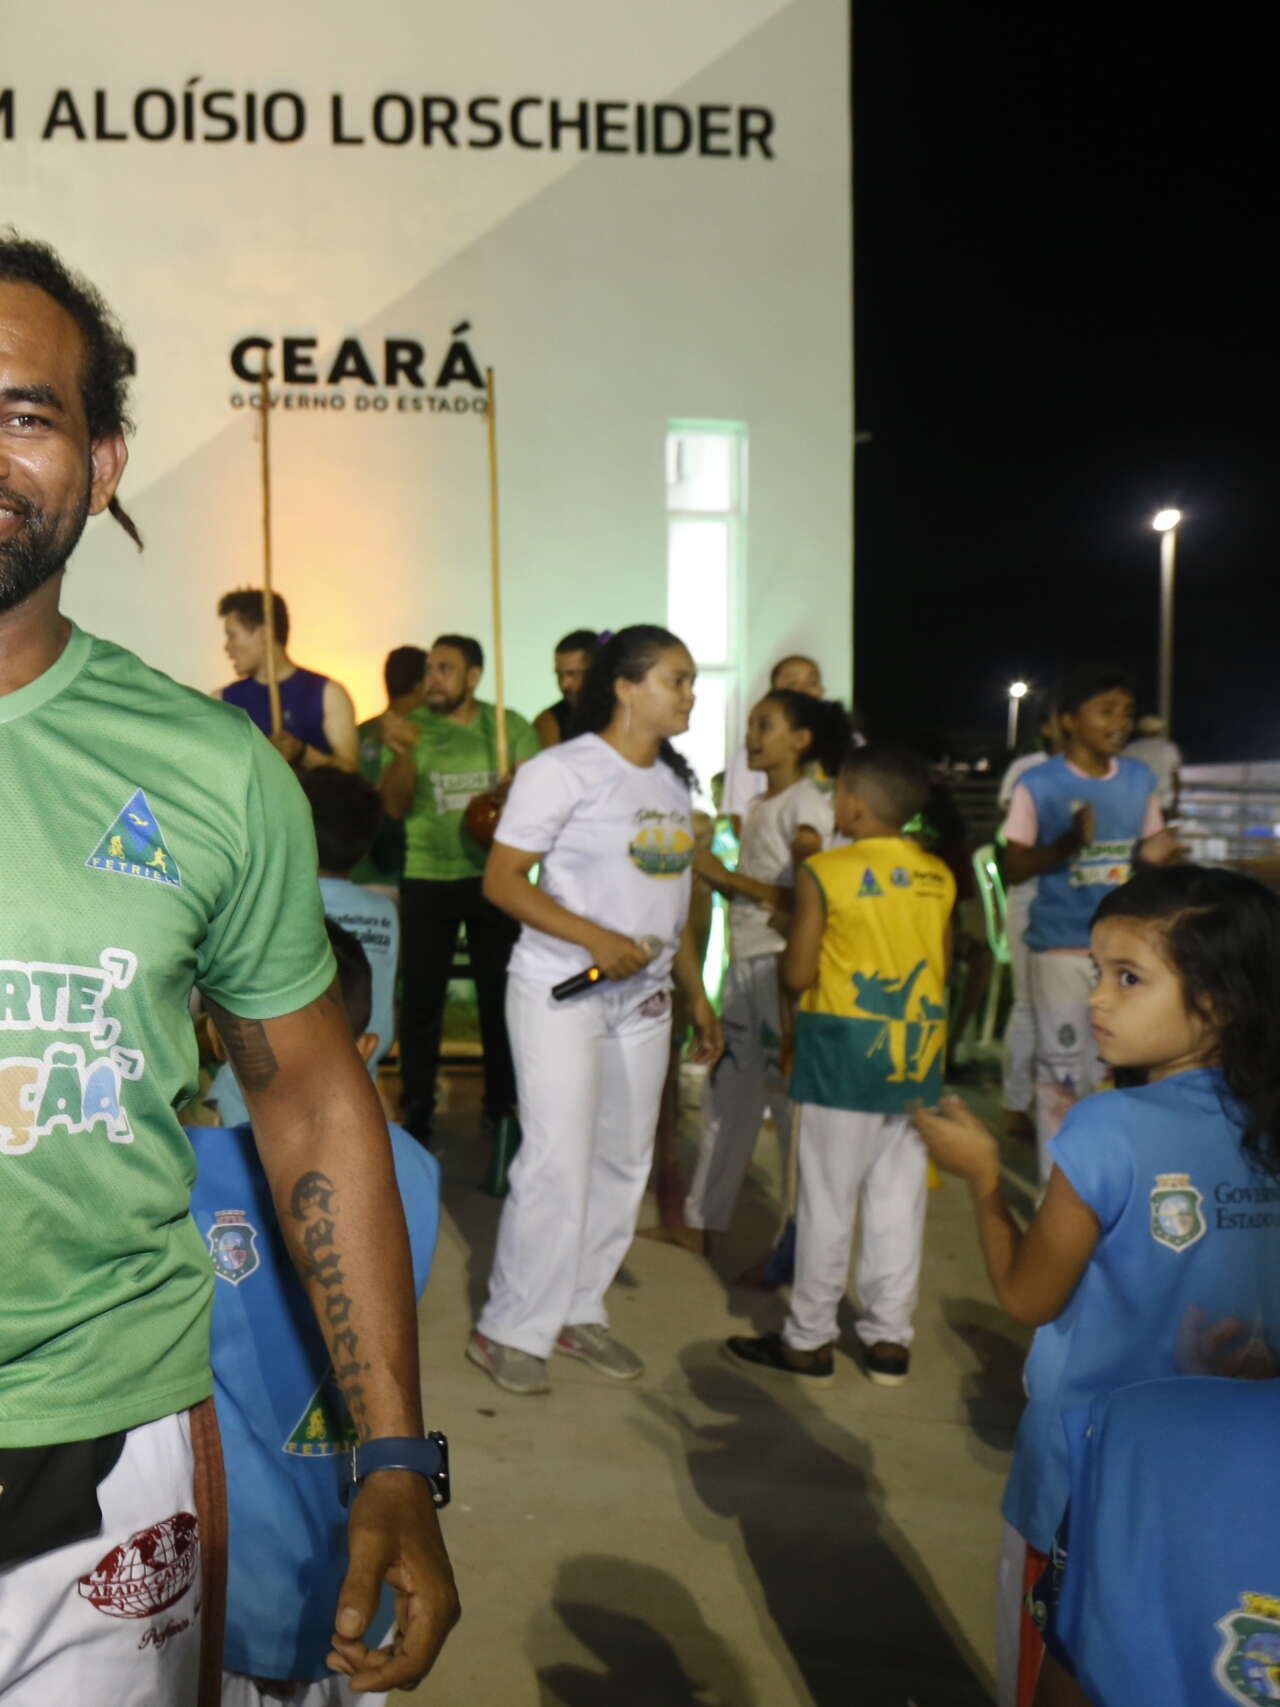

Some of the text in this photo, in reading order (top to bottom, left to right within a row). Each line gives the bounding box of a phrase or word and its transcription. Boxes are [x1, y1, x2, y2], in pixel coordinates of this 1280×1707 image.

[42, 77, 306, 143] ALOÍSIO
[331, 93, 776, 159] LORSCHEIDER
[230, 321, 486, 389] CEARÁ
[230, 393, 488, 414] GOVERNO DO ESTADO
